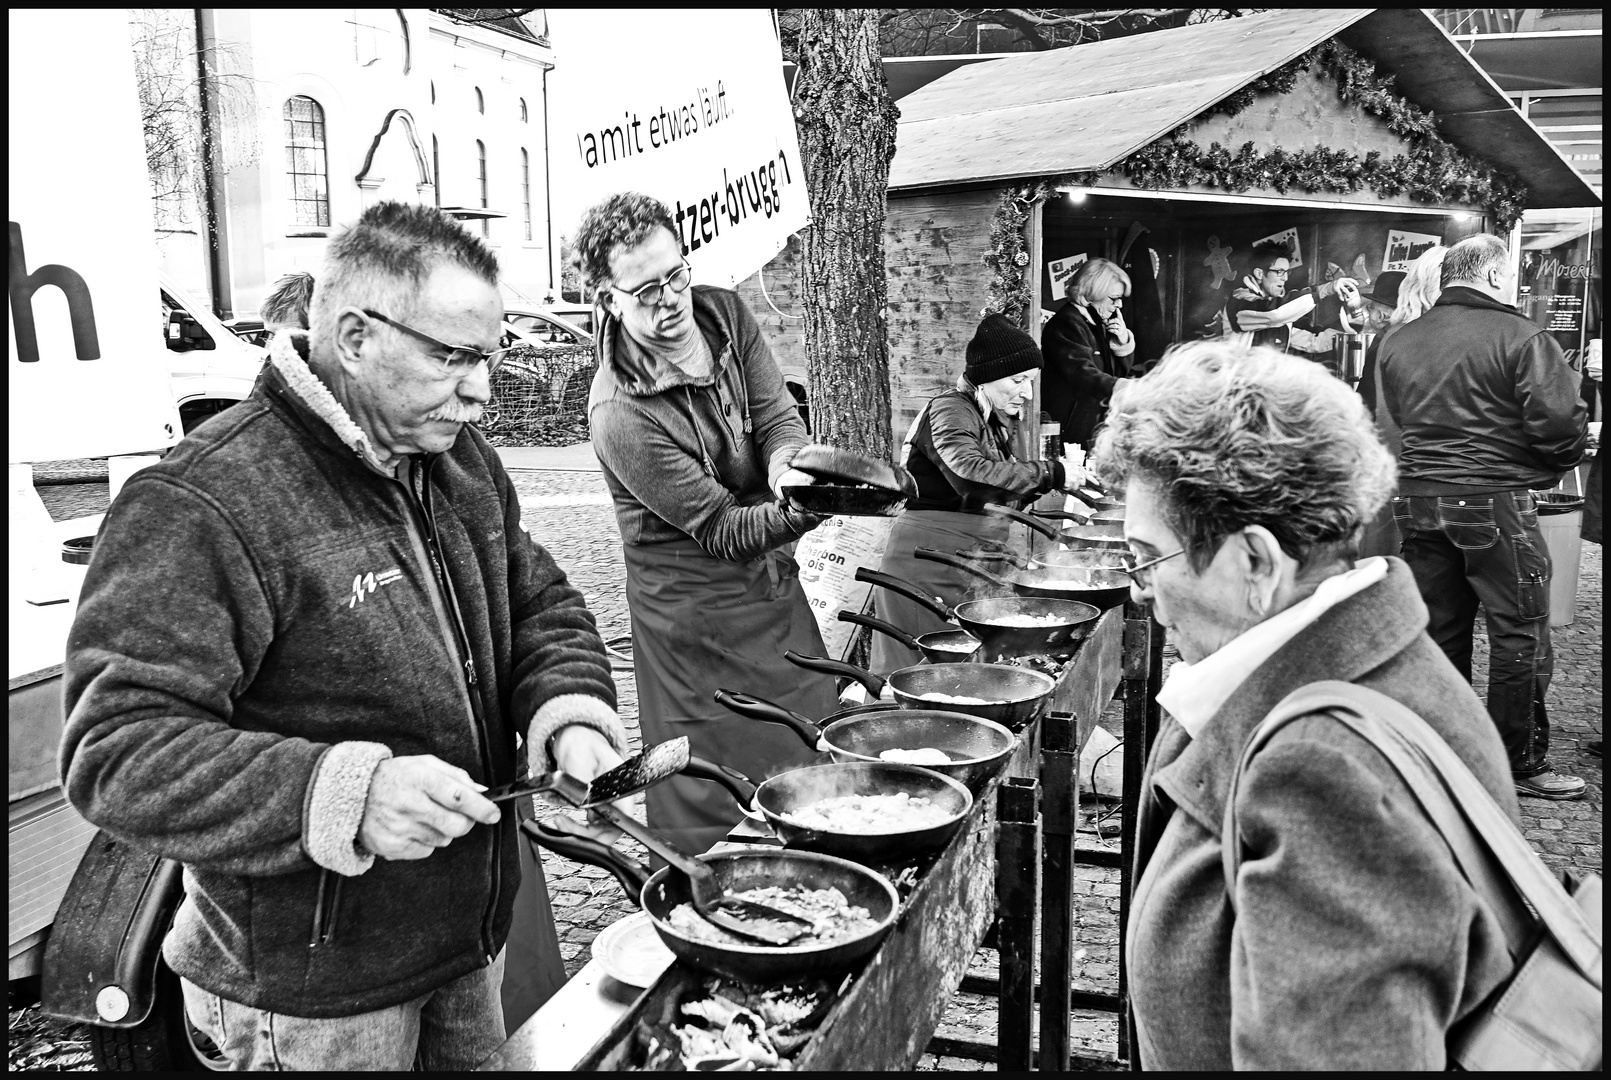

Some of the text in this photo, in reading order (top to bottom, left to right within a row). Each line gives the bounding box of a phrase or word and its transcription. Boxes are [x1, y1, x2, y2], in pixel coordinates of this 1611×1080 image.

[577, 111, 643, 168] amit
[650, 103, 698, 148] etwas
[9, 221, 101, 363] h
